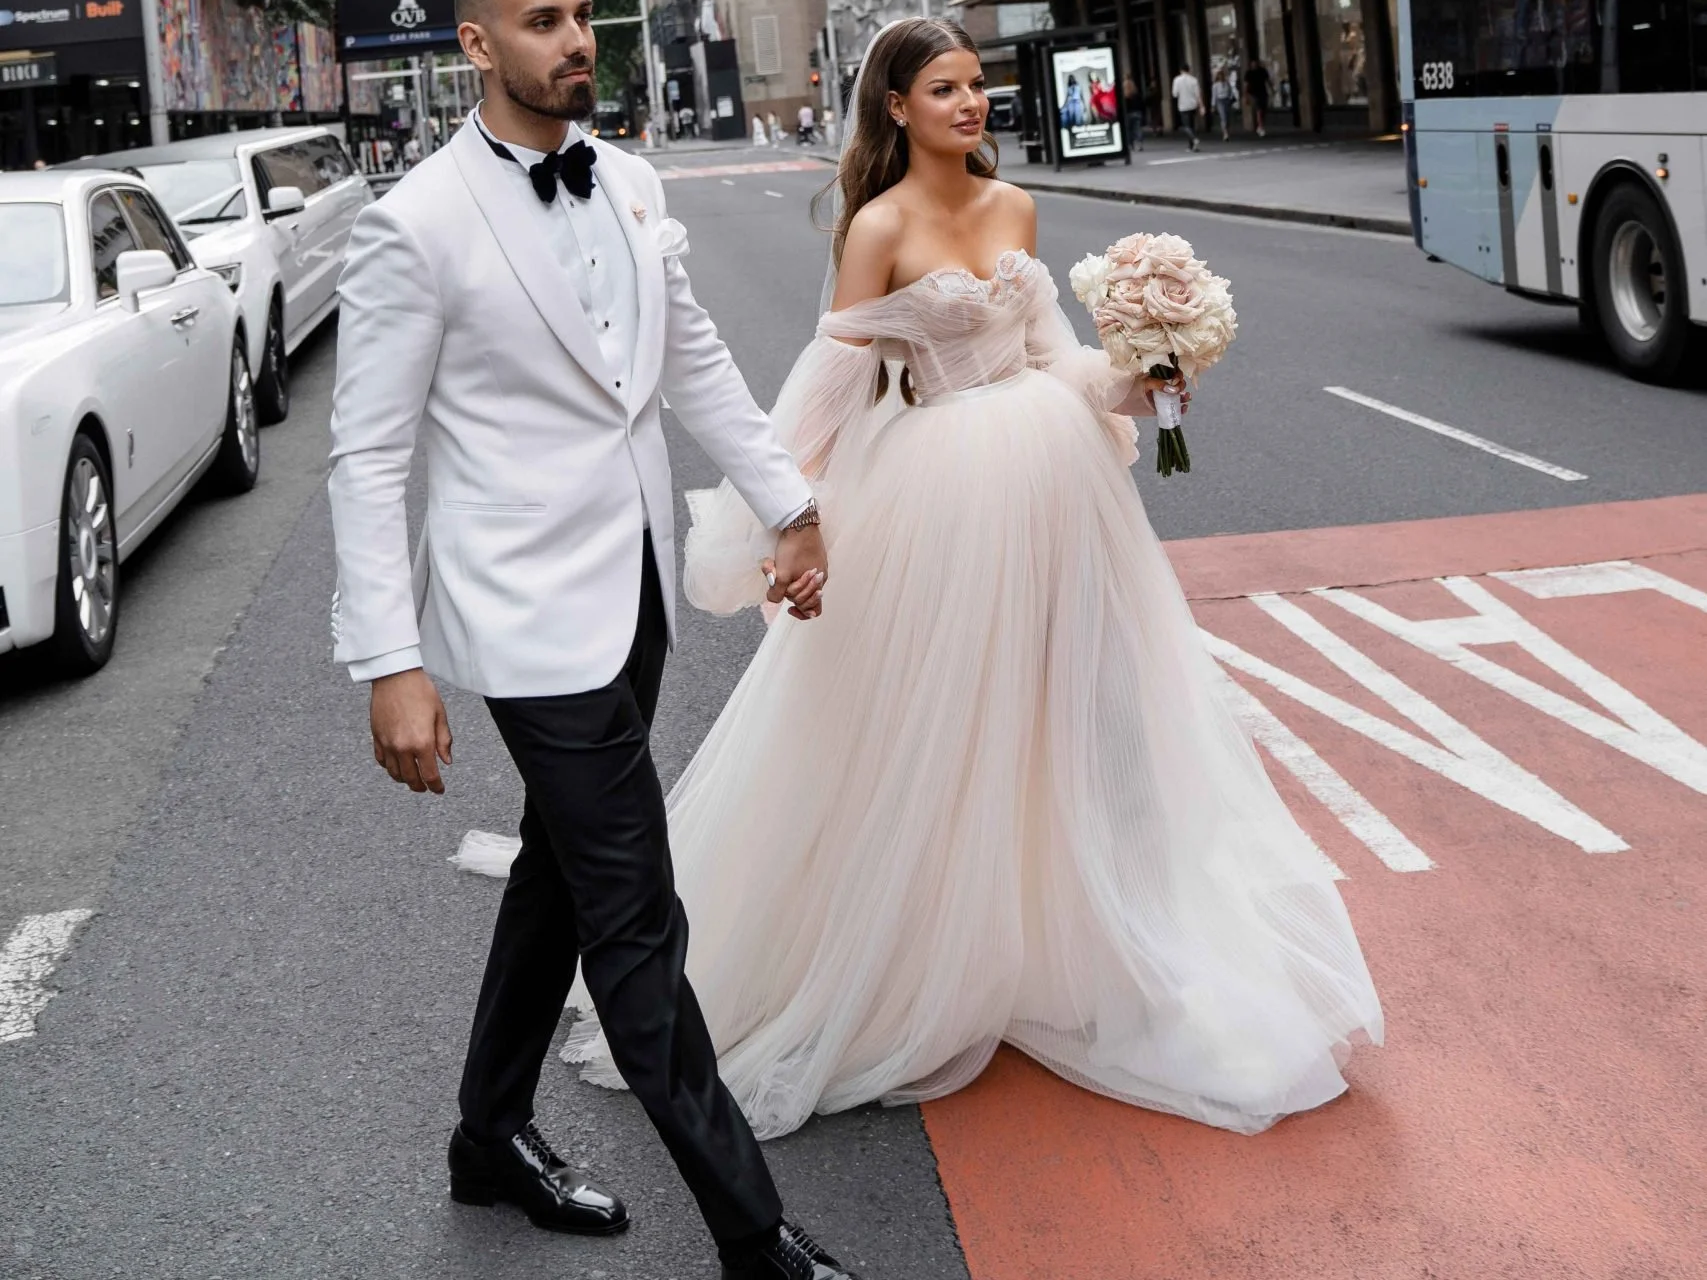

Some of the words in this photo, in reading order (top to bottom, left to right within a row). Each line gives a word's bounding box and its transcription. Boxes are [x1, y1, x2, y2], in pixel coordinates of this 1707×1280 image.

[14, 9, 70, 23] Spectrum
[86, 0, 124, 18] Built
[390, 7, 427, 28] QVB
[345, 36, 356, 48] P
[389, 33, 407, 42] CAR
[409, 31, 431, 40] PARK
[1423, 61, 1454, 90] 6338
[1197, 561, 1707, 879] AN
